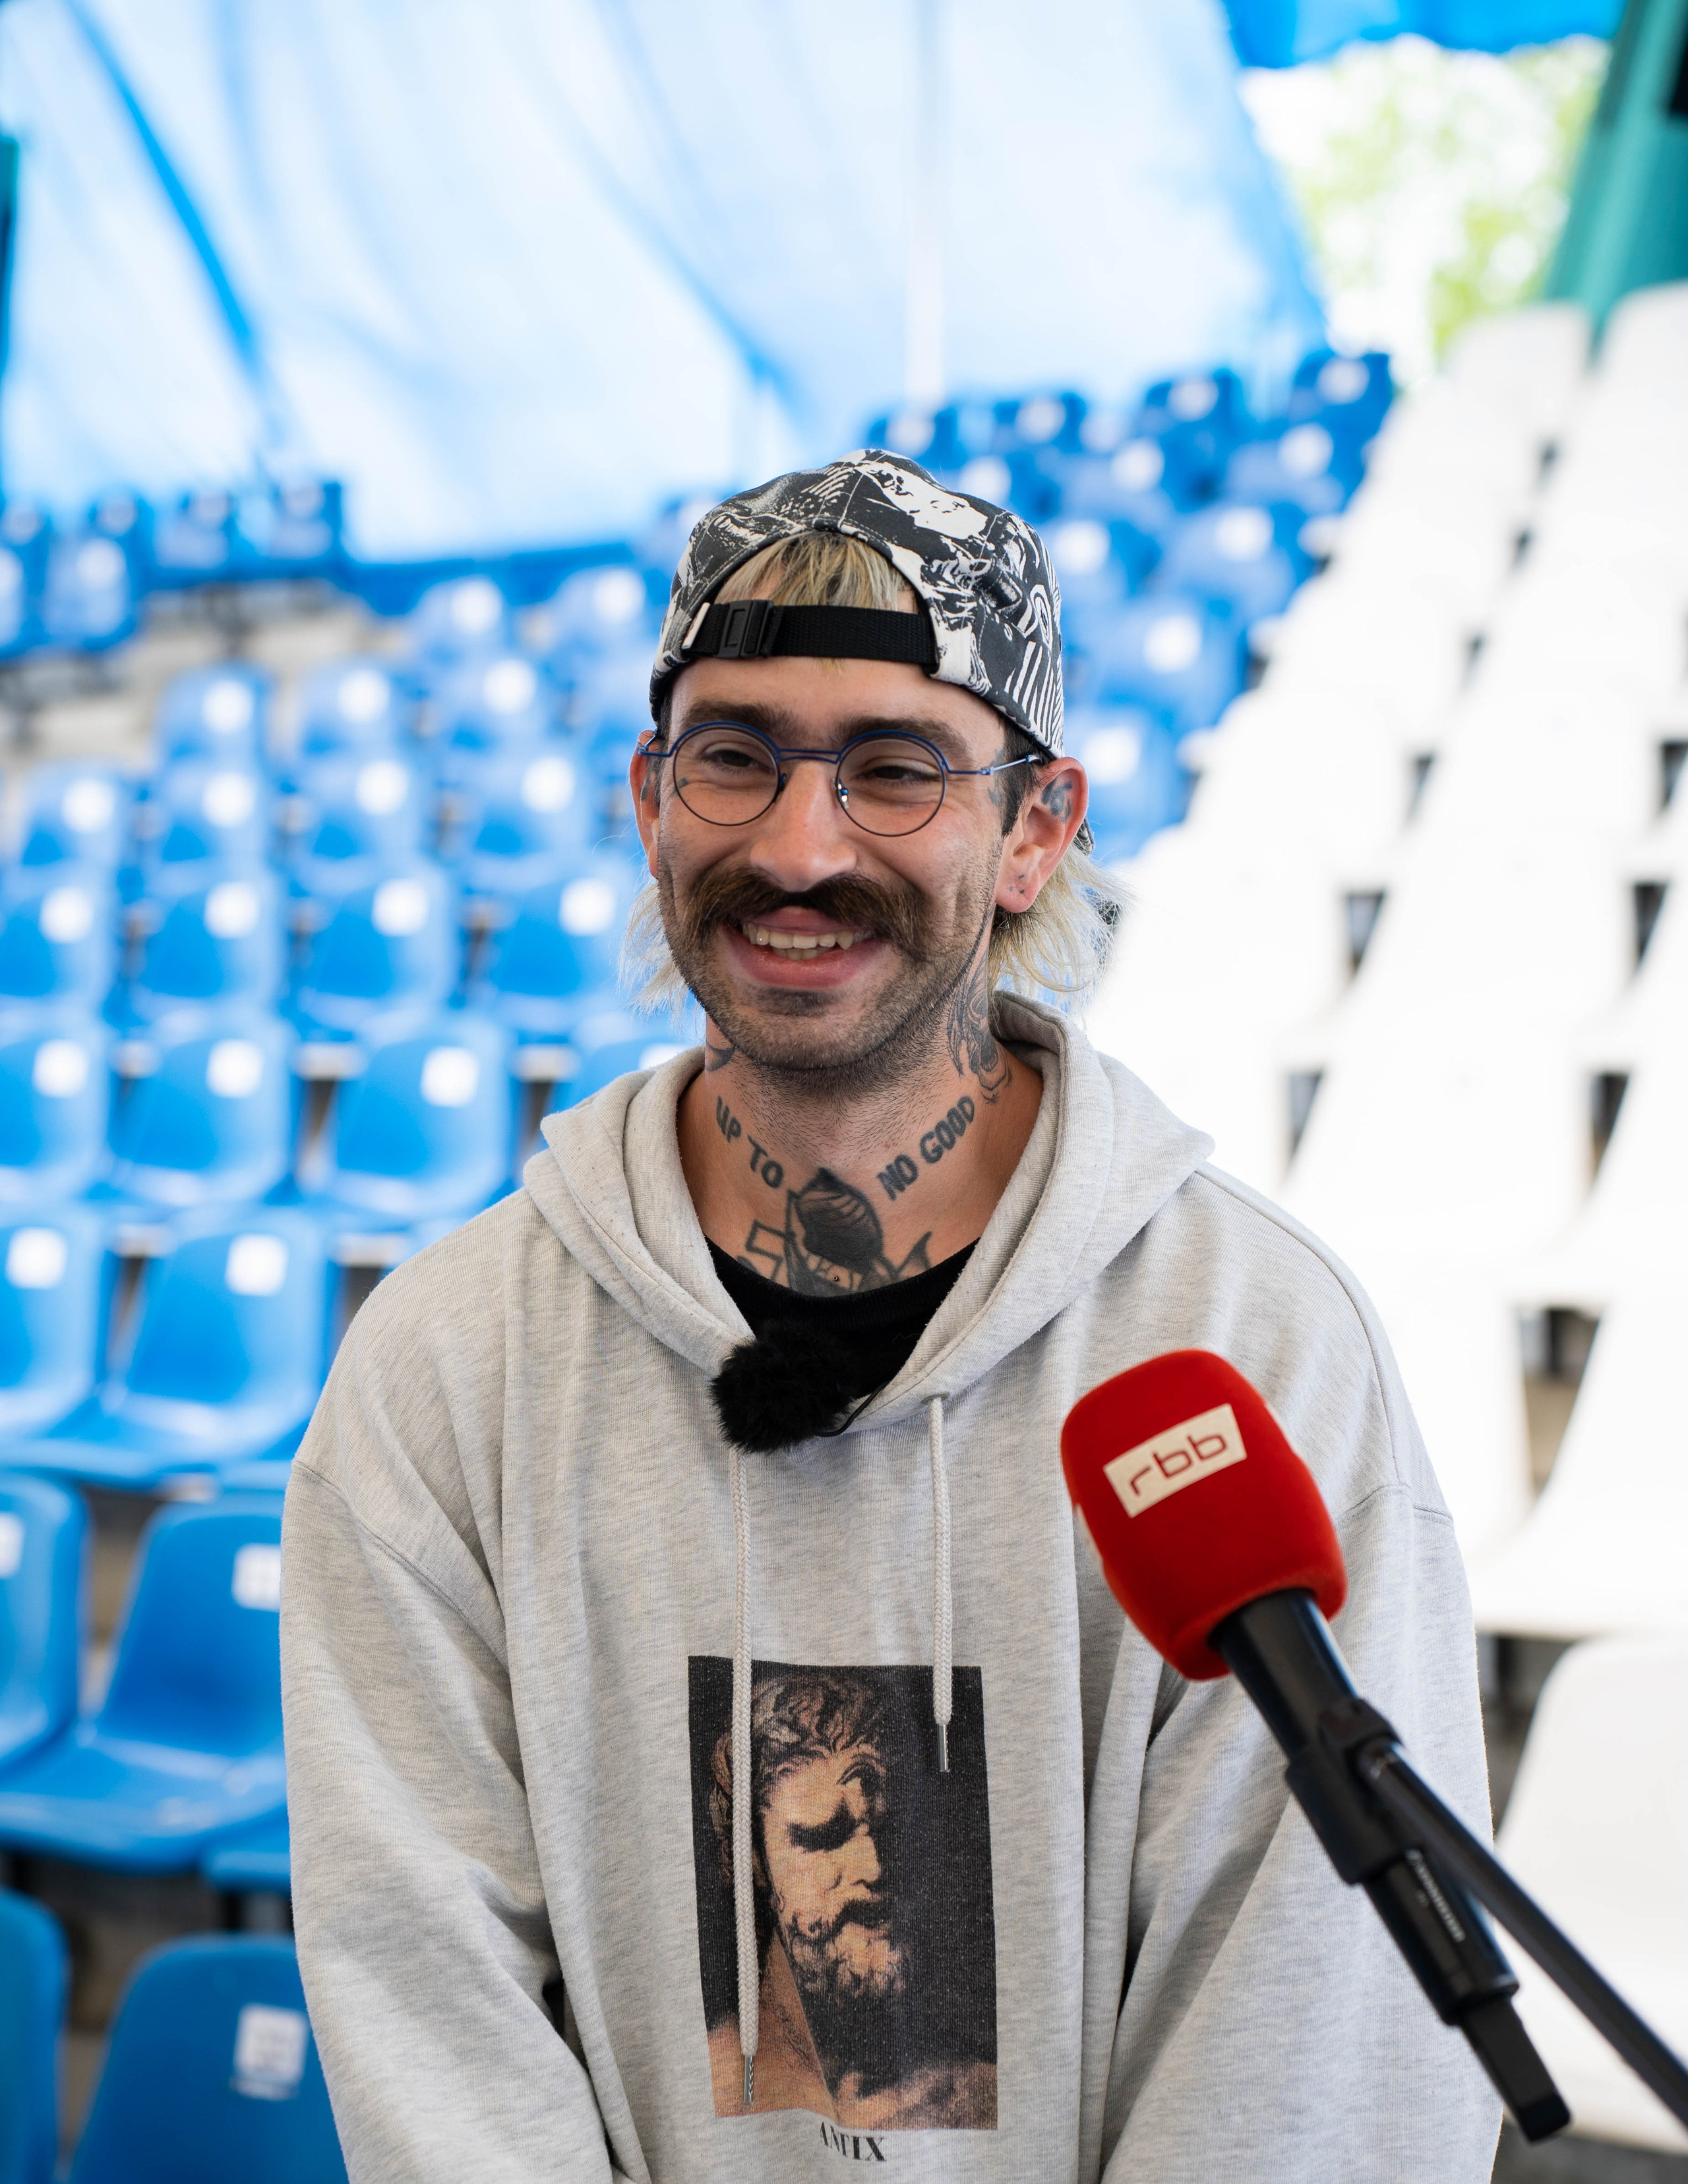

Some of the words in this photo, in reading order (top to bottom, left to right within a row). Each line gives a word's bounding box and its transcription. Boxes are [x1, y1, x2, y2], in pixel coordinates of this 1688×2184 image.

[716, 1095, 741, 1142] UP
[748, 1136, 784, 1188] TO
[876, 1154, 918, 1200] NO
[920, 1096, 975, 1164] GOOD
[1130, 1434, 1226, 1496] rbb
